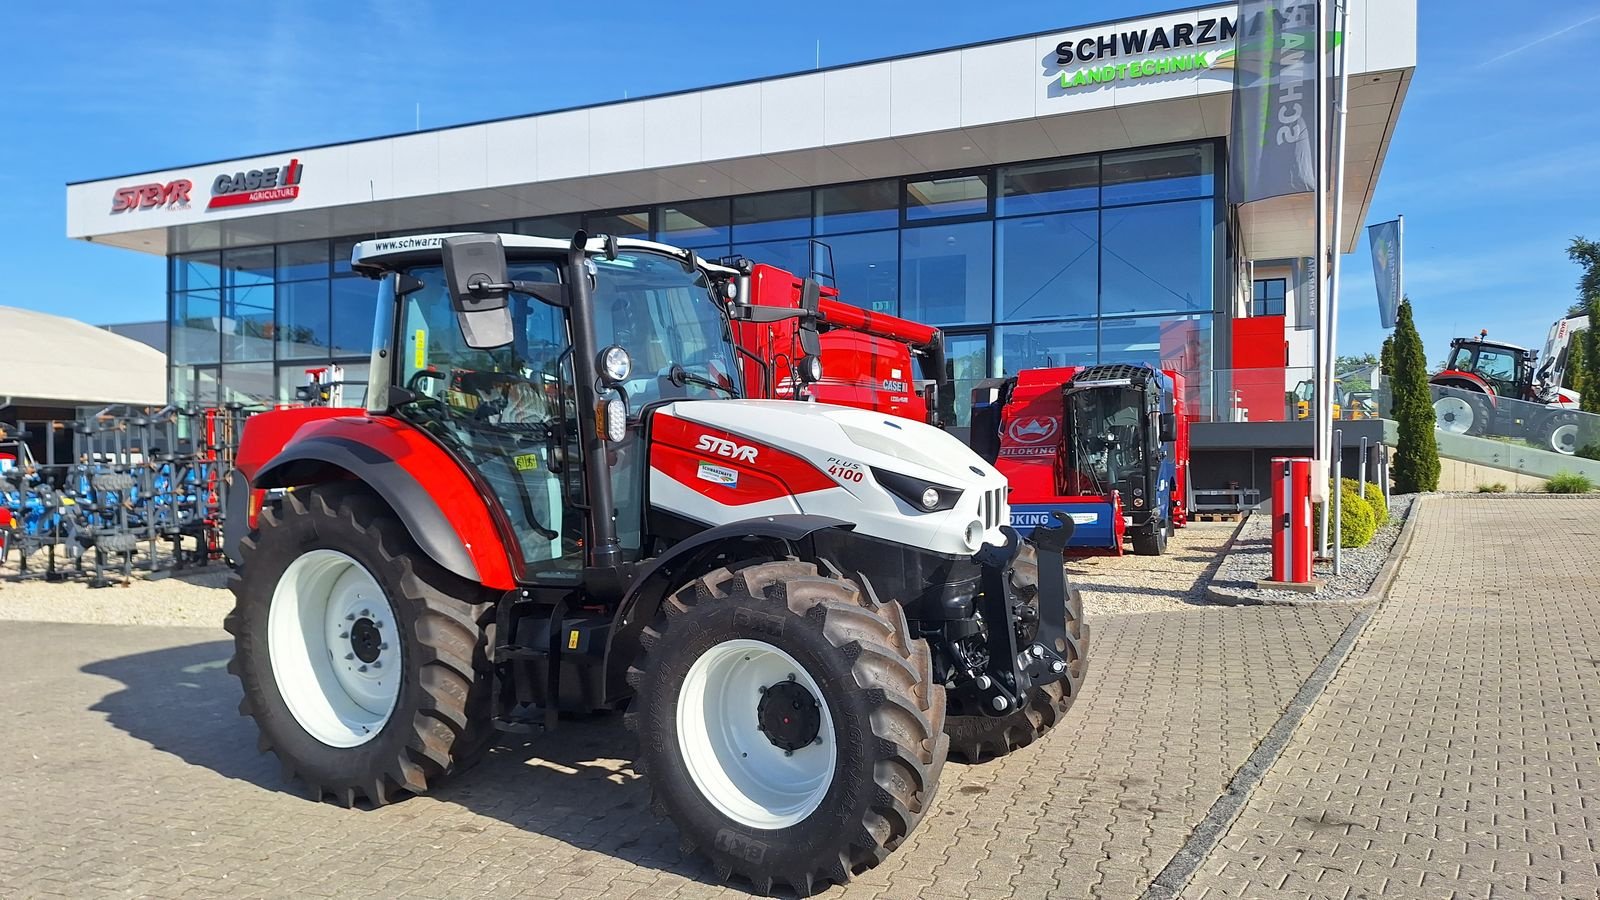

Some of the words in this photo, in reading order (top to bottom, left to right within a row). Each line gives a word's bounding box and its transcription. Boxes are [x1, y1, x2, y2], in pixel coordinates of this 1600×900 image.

[1056, 6, 1316, 65] SCHWARZMA
[1060, 51, 1209, 88] LANDTECHNIK
[213, 167, 280, 194] CASE
[113, 179, 193, 212] STEYR
[249, 187, 295, 201] AGRICULTURE
[882, 379, 903, 393] CASE
[695, 434, 759, 464] STEYR
[1000, 446, 1056, 455] SILOKING
[826, 456, 862, 470] PLUS
[827, 464, 864, 483] 4100
